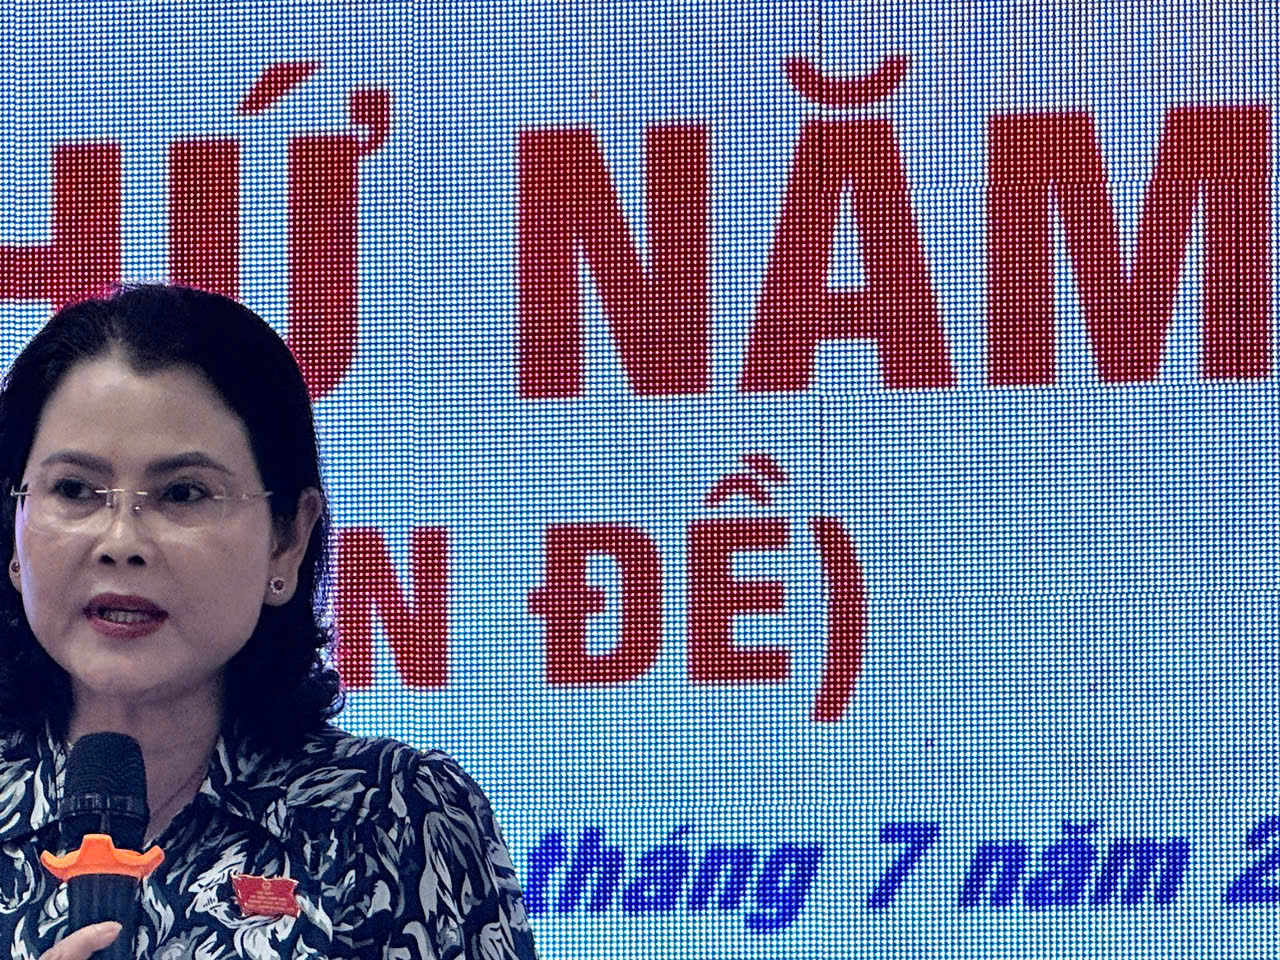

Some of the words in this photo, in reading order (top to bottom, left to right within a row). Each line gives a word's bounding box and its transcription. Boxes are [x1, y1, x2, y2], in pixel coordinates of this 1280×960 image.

[516, 54, 1271, 399] NĂM
[528, 453, 866, 721] ĐỀ)
[521, 824, 822, 934] tháng
[866, 821, 942, 909] 7
[958, 819, 1191, 908] năm
